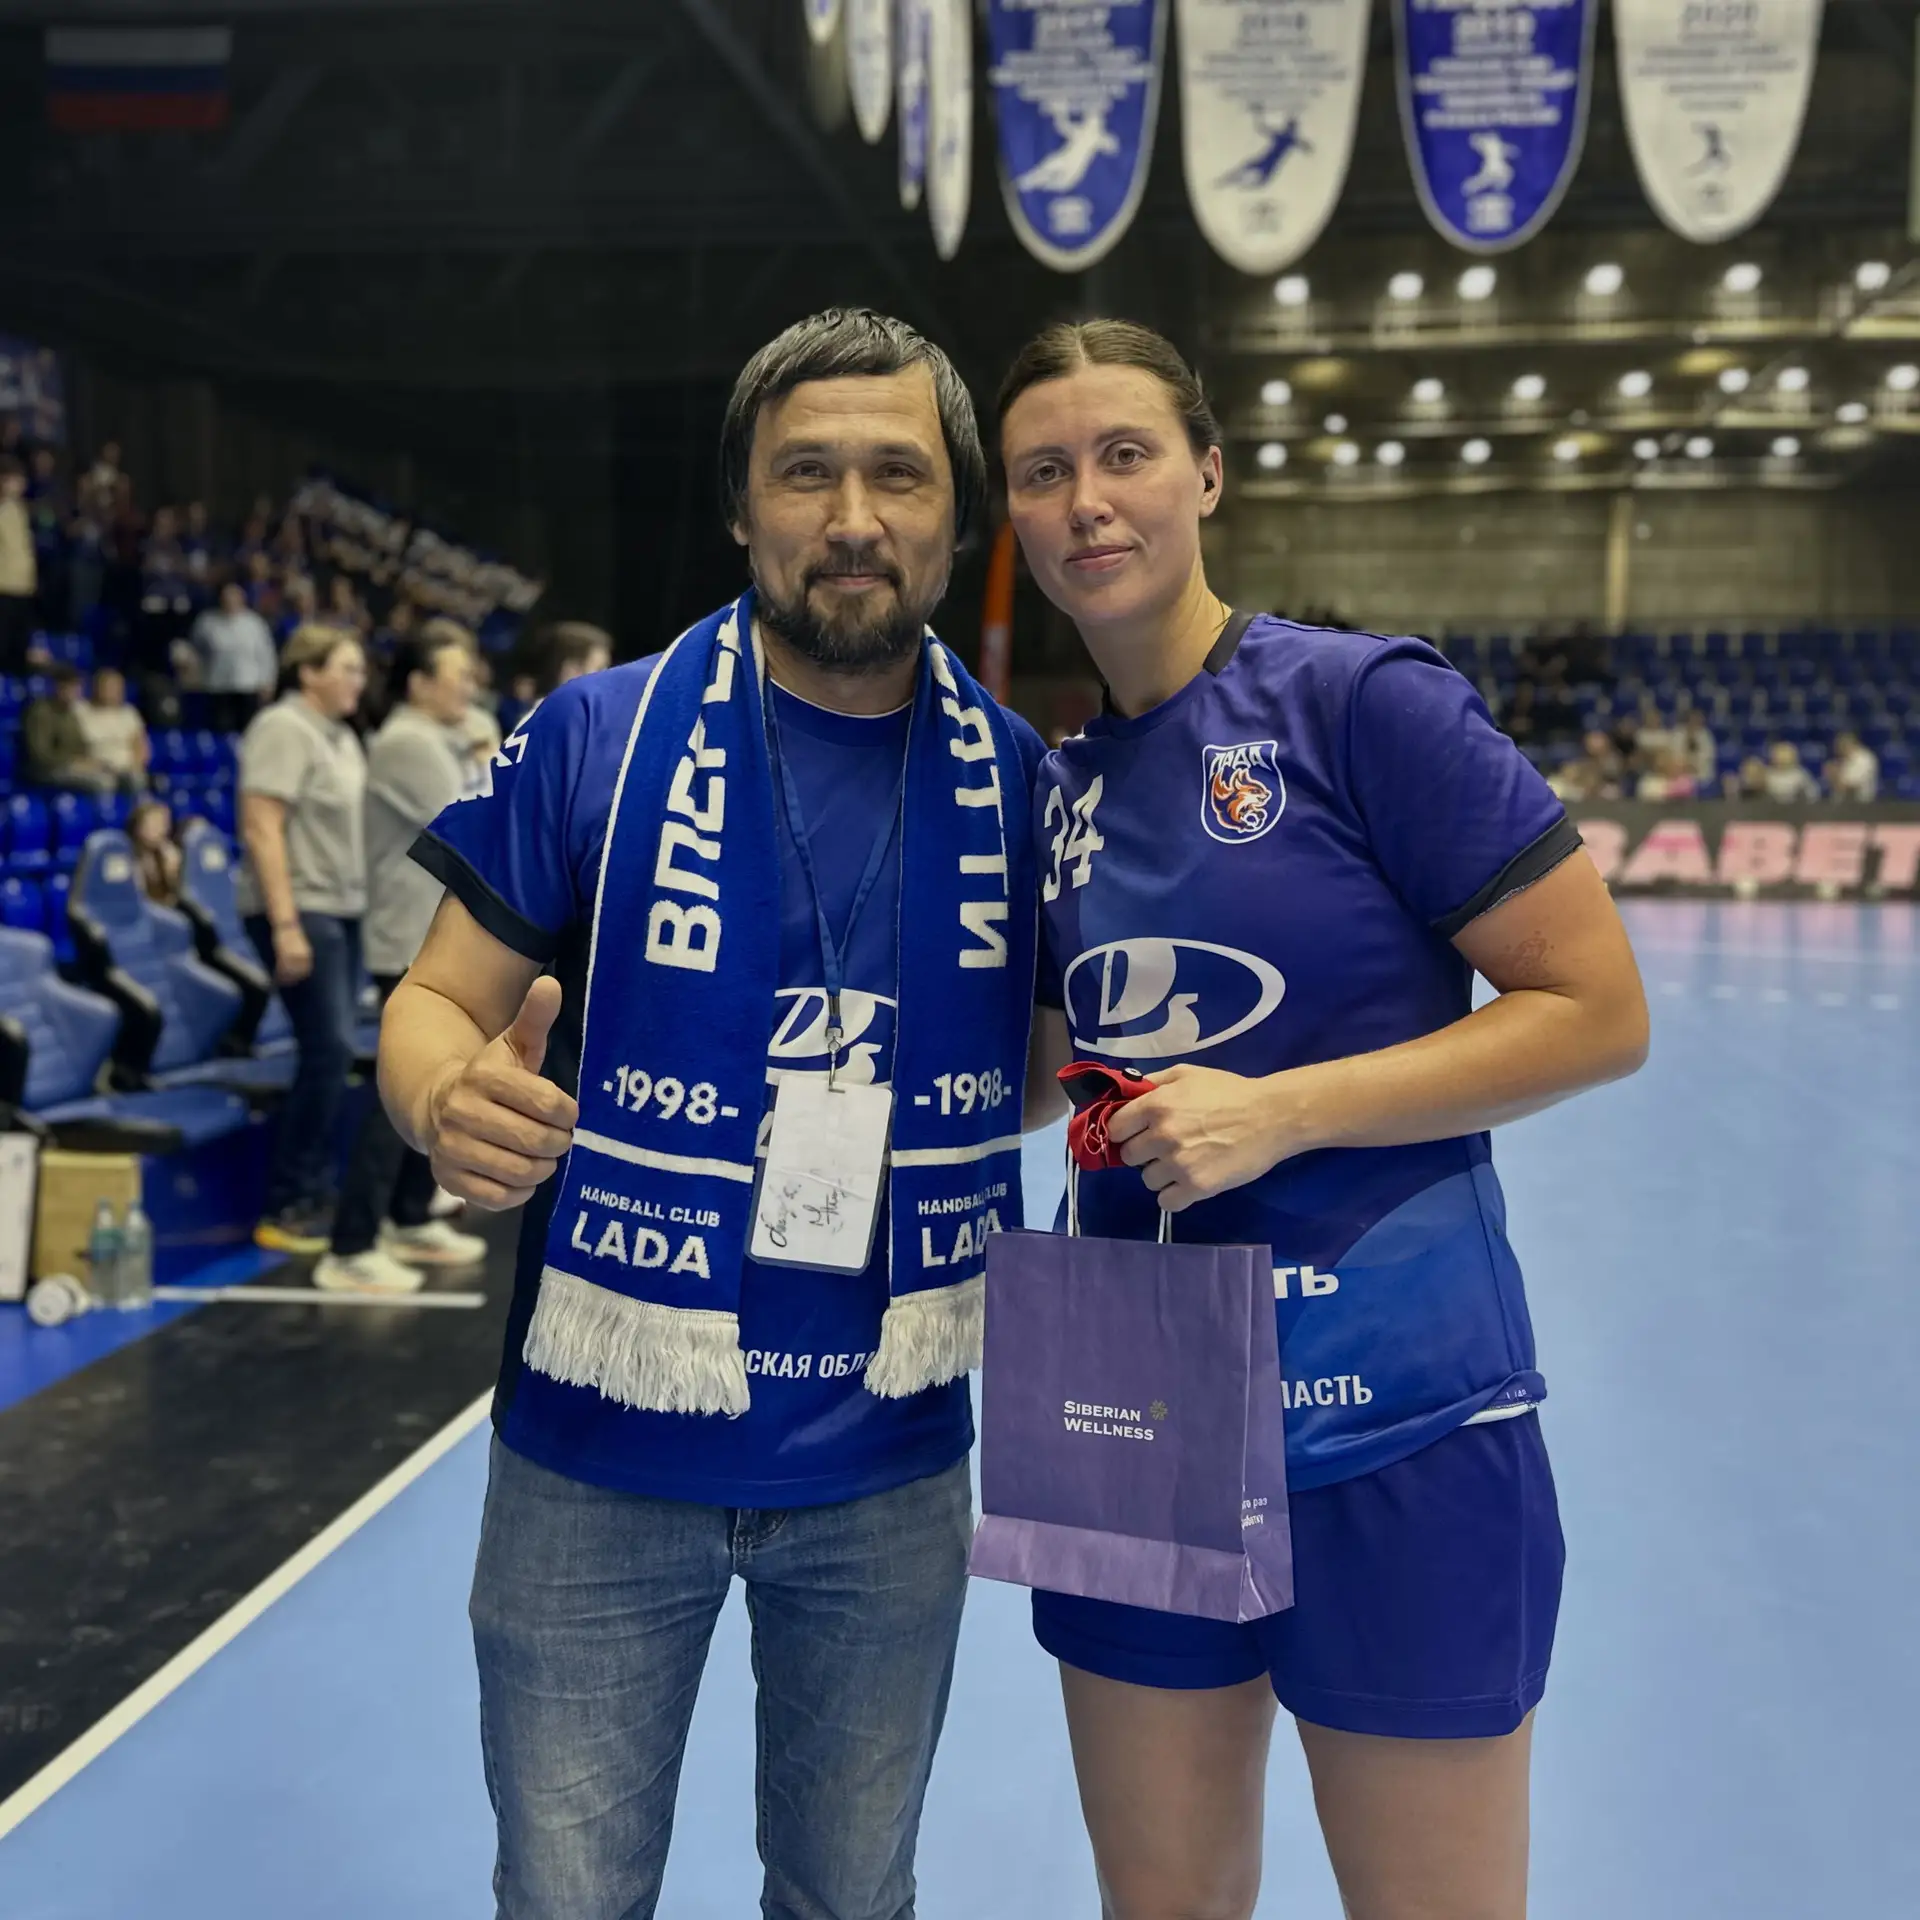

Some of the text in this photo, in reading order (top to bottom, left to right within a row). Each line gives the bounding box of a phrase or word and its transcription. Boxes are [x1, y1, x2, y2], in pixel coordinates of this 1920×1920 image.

[1043, 774, 1104, 903] 34
[580, 1184, 720, 1228] HANDBALL CLUB
[571, 1210, 711, 1279] LADA
[740, 1349, 812, 1378] СКАЯ
[1063, 1400, 1141, 1422] SIBERIAN
[1063, 1417, 1154, 1441] WELLNESS
